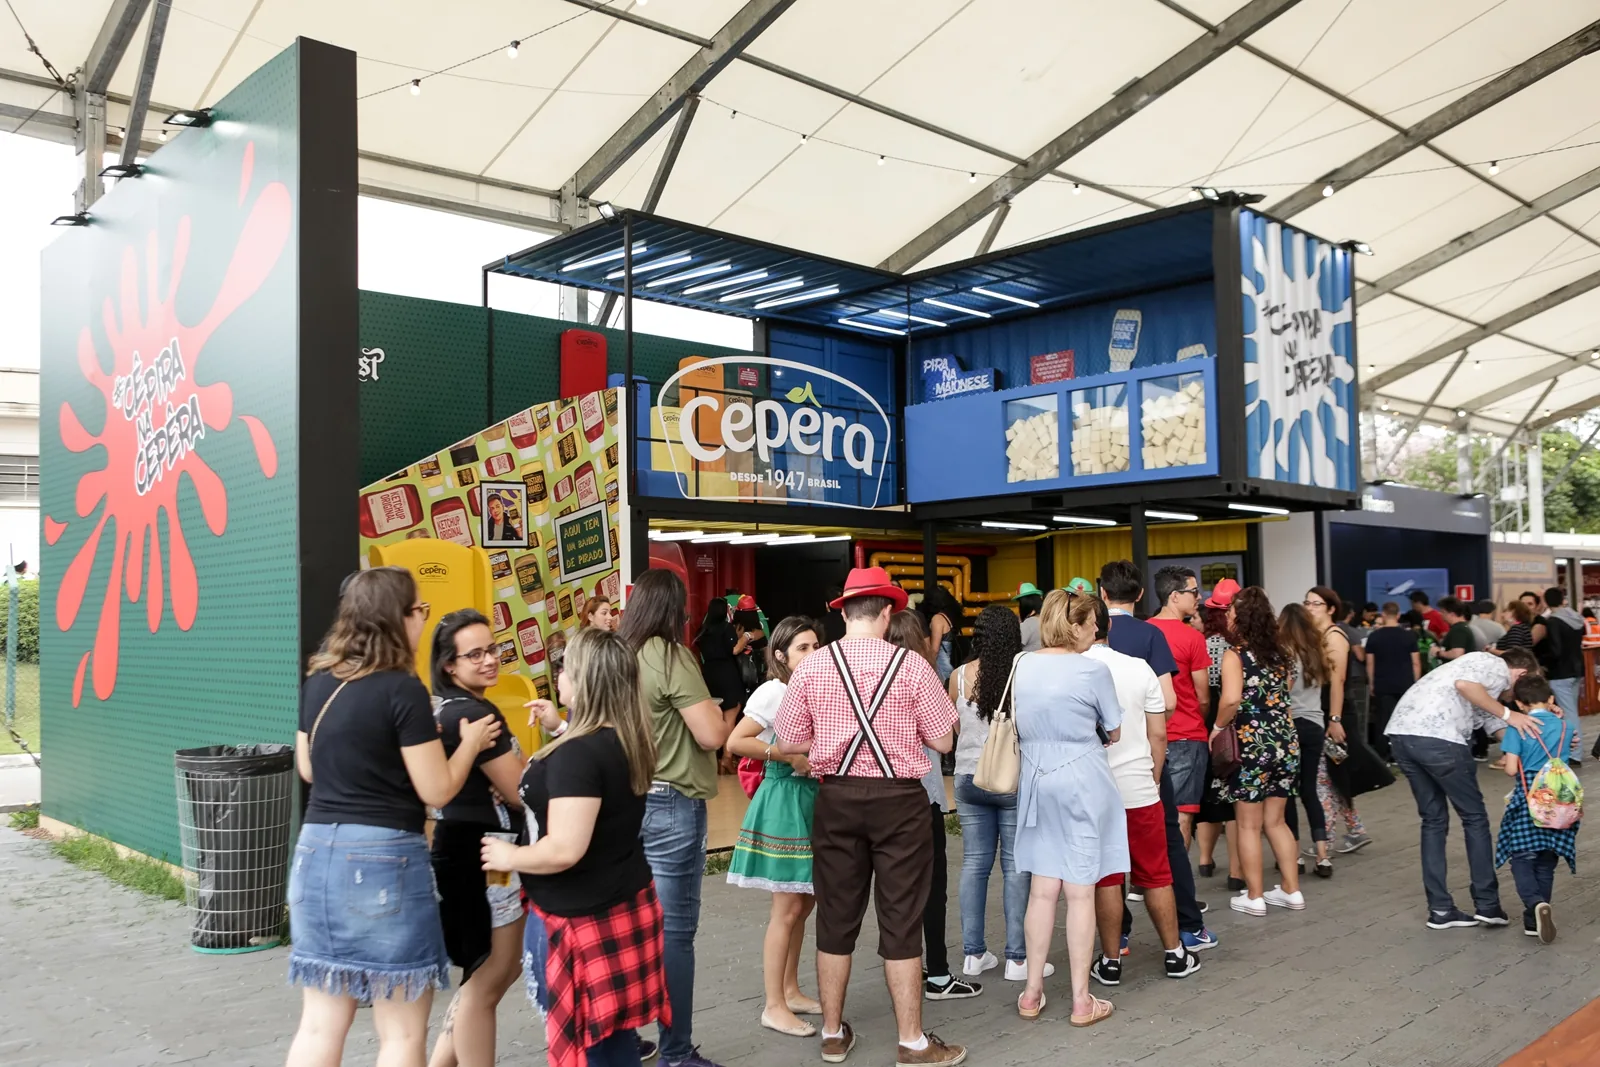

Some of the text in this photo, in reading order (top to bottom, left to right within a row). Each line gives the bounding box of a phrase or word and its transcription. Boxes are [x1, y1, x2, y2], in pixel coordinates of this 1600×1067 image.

[923, 358, 949, 374] PIRA
[943, 368, 957, 382] NA
[935, 374, 991, 396] MAIONESE
[730, 469, 841, 491] DESDE 1947 BRASIL
[380, 494, 395, 523] ORIGINAL
[390, 491, 405, 520] KETCHUP
[437, 515, 460, 530] KETCHUP
[564, 516, 600, 538] AQUI TEM
[439, 527, 463, 540] ORIGINAL
[567, 534, 599, 552] UM BANDO
[566, 557, 576, 568] DE
[578, 549, 604, 564] PIRADO
